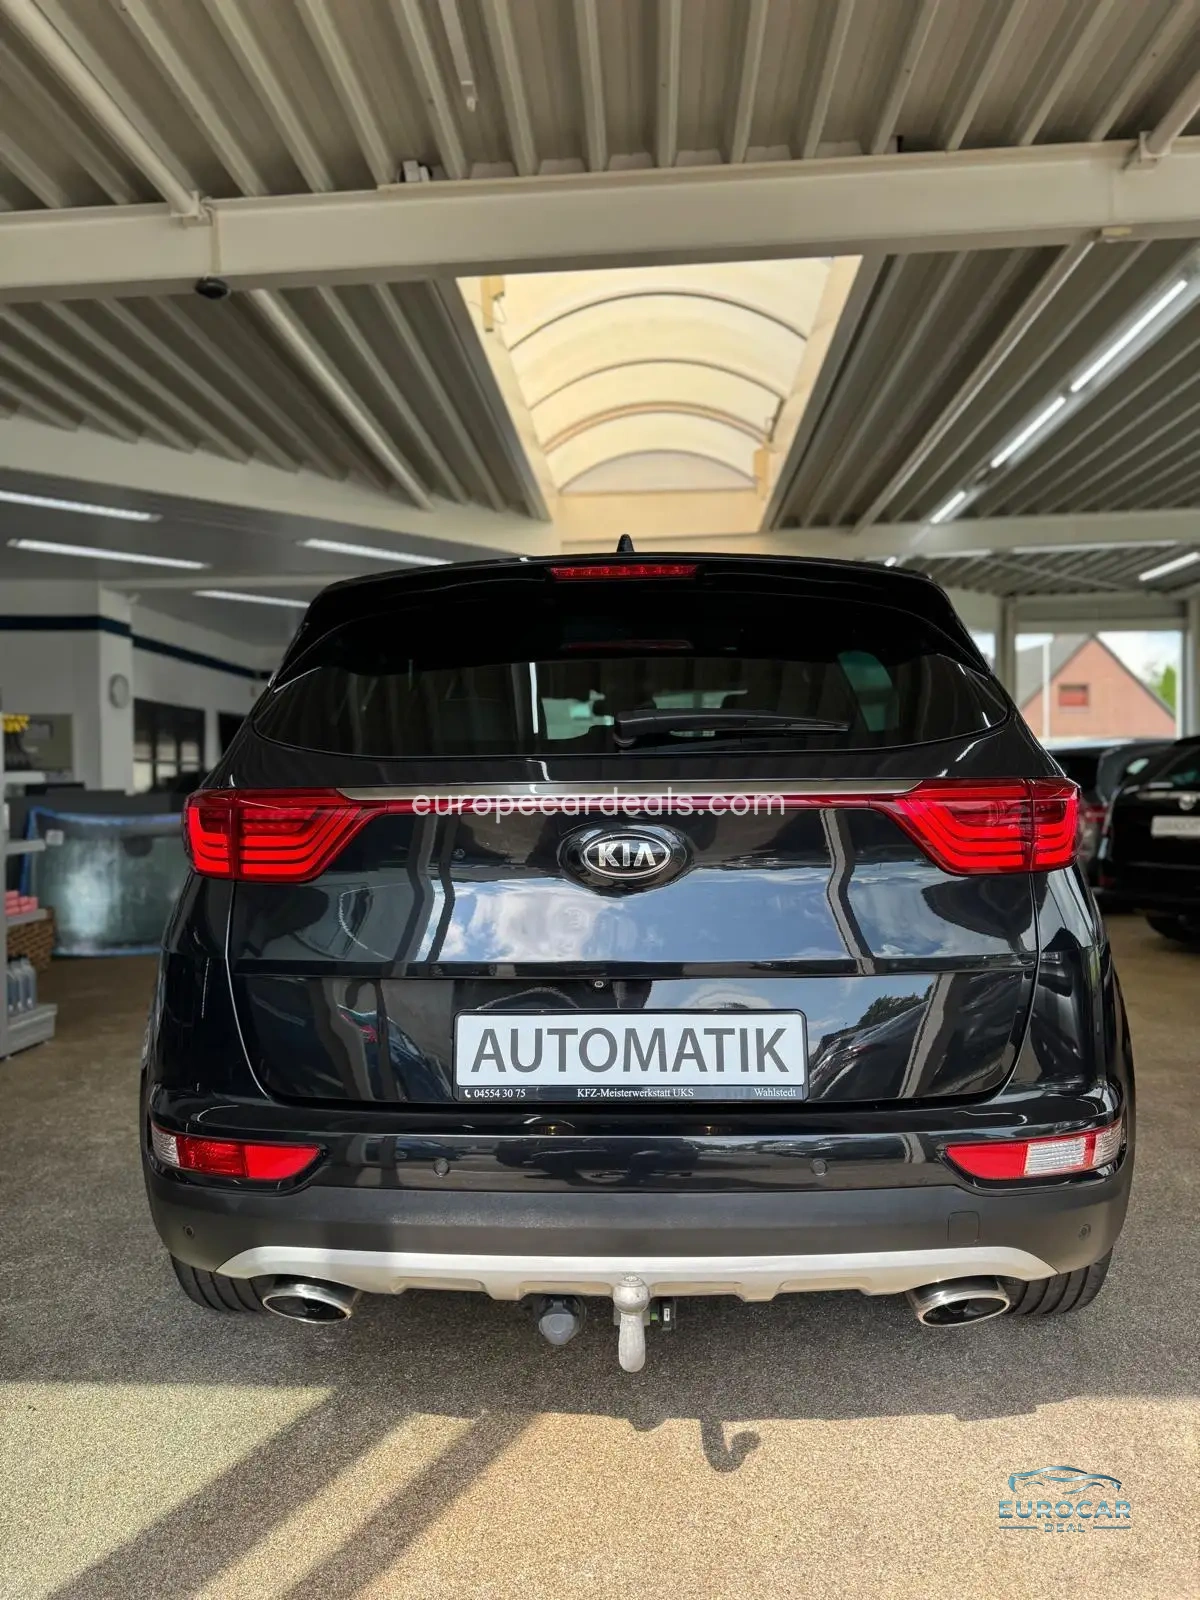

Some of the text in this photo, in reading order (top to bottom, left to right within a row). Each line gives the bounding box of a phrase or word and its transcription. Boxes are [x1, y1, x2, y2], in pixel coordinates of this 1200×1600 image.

[598, 843, 657, 867] KIA
[470, 1027, 790, 1073] AUTOMATIK
[473, 1088, 526, 1098] 04554 30 75
[576, 1088, 695, 1098] KFZ-Meisterwerkstatt UKS
[753, 1087, 797, 1097] Wahlstedt
